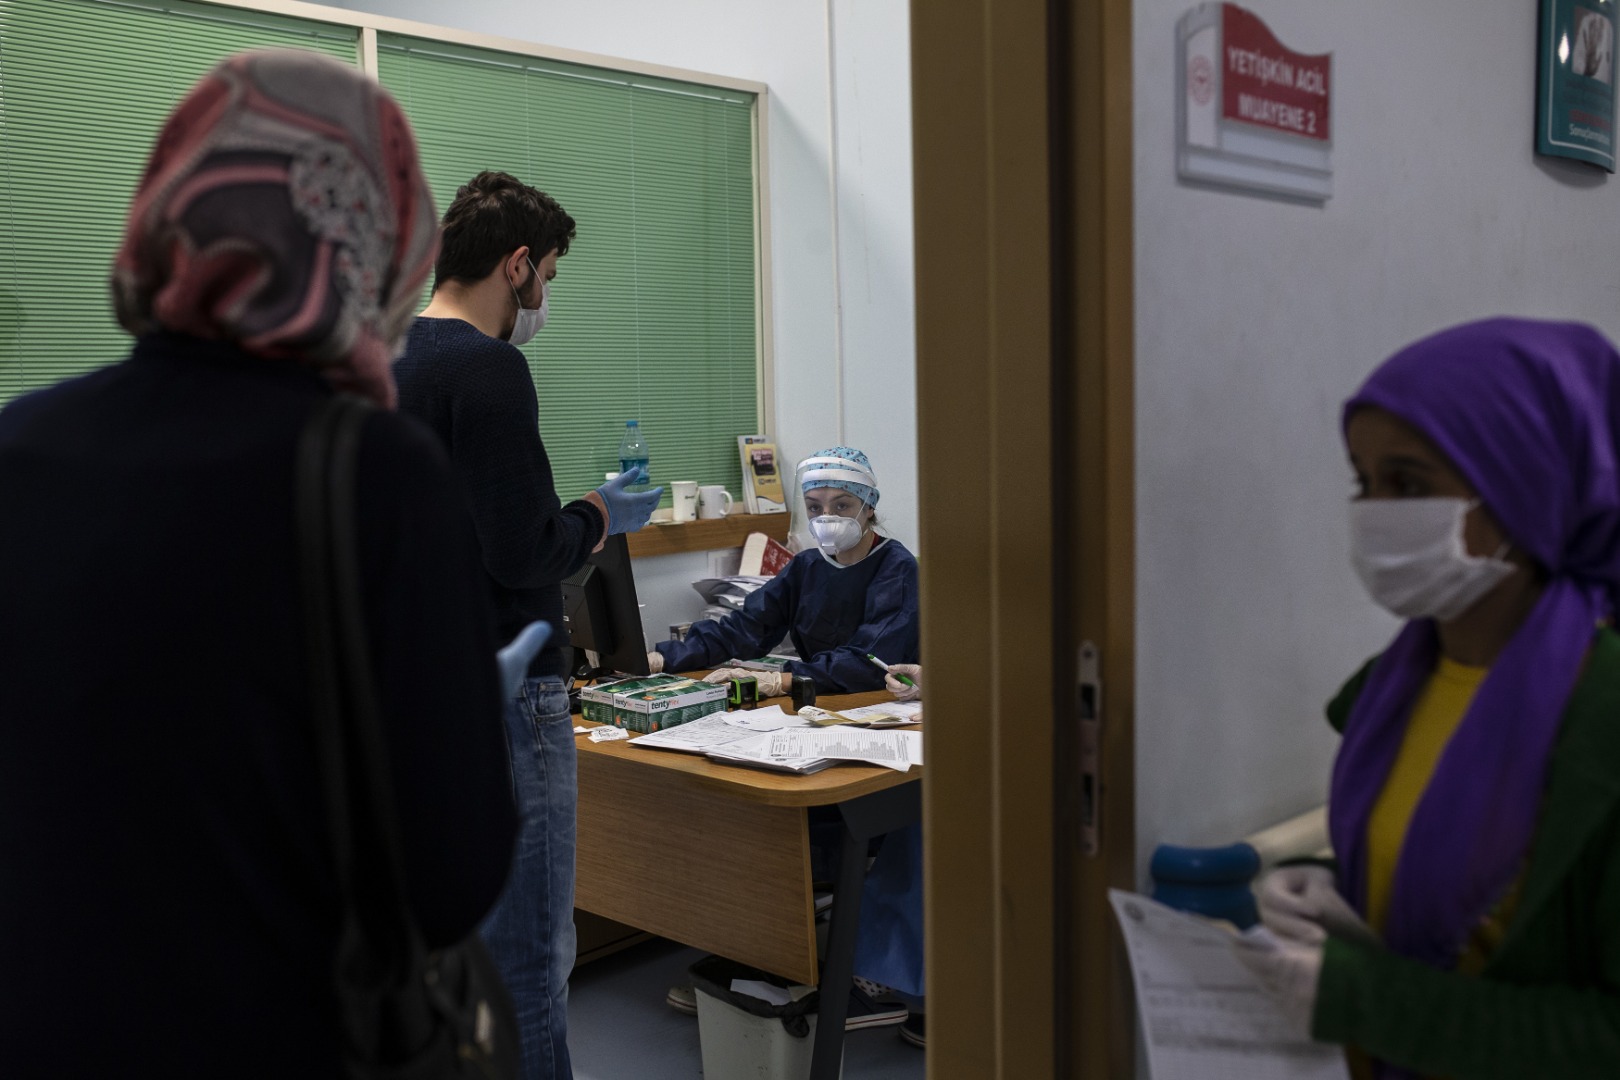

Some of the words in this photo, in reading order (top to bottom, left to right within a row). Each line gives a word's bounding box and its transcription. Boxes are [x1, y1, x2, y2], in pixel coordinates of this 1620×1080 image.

[1227, 46, 1294, 86] YETİŞKİN
[1238, 93, 1305, 130] MUAYENE
[1306, 112, 1317, 134] 2
